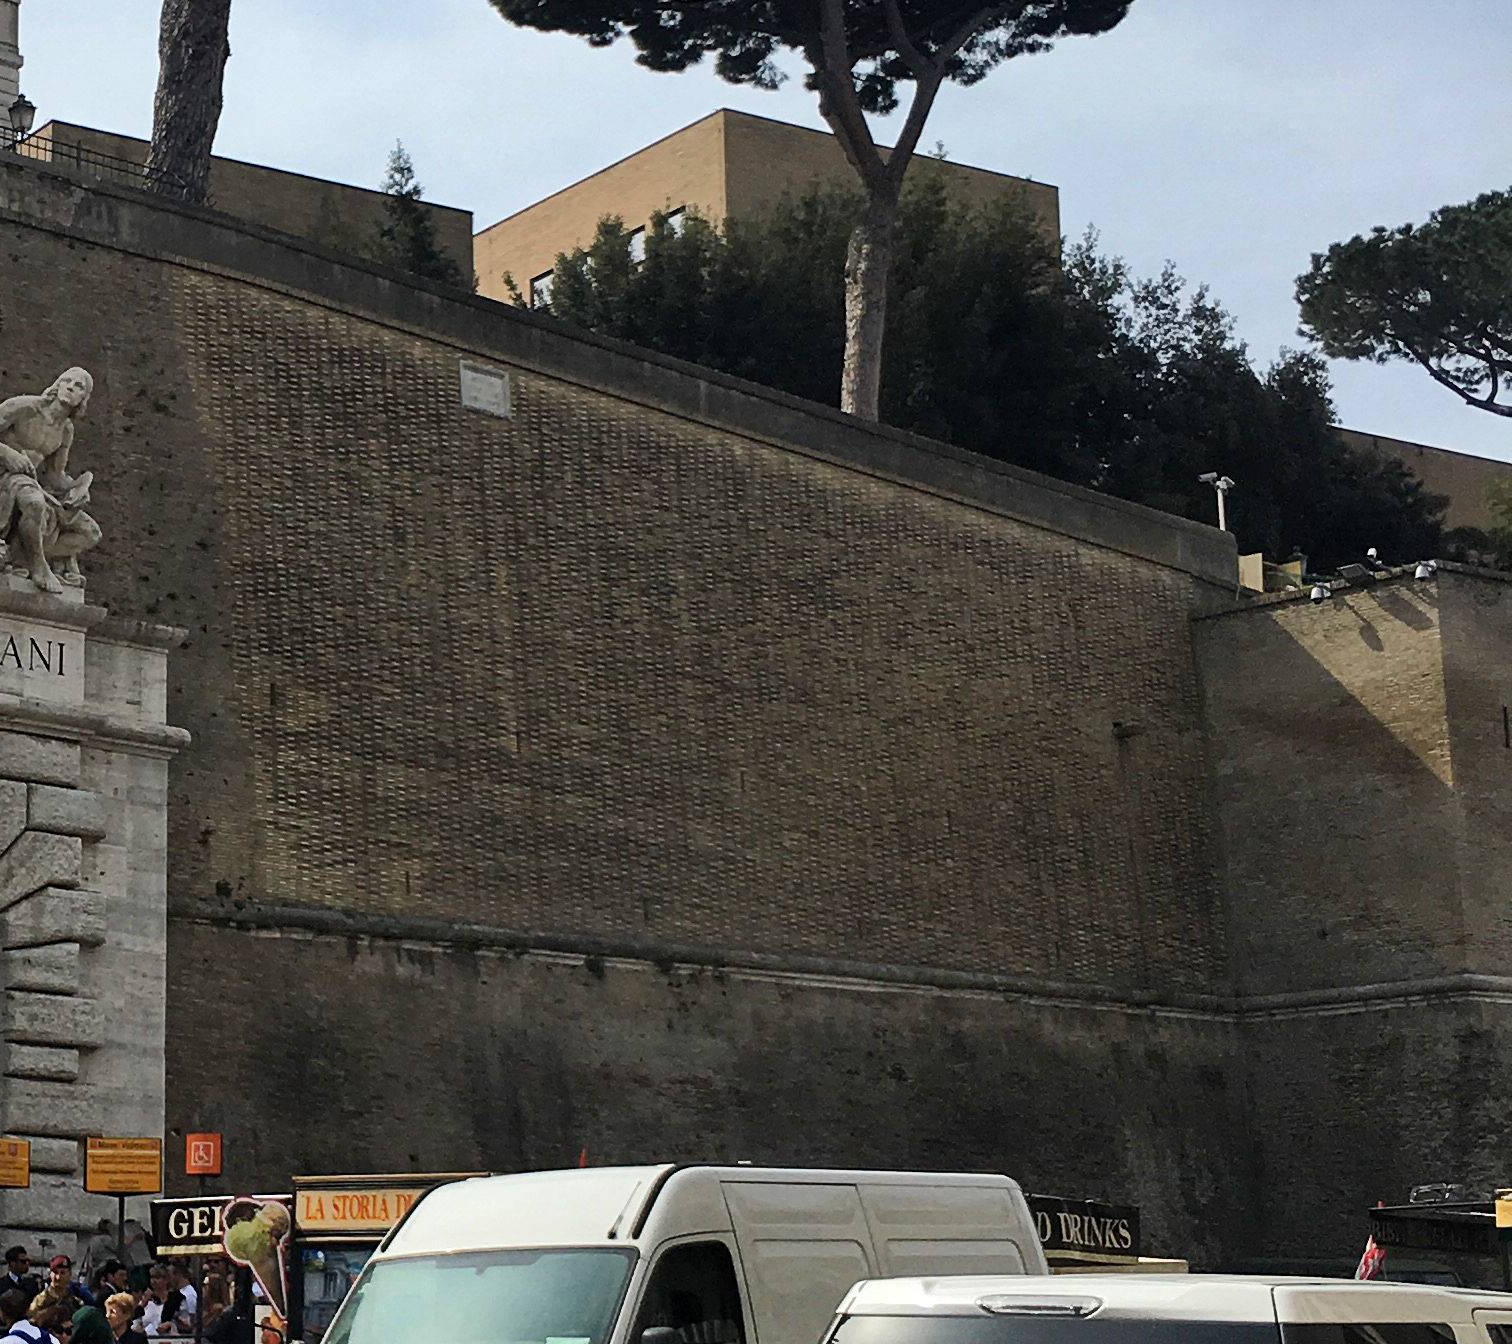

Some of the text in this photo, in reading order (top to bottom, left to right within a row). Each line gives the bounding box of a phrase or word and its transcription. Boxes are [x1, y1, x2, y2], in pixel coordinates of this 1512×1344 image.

[304, 1194, 327, 1221] LA
[332, 1194, 389, 1222] STORIA
[1056, 1212, 1132, 1249] DRINKS
